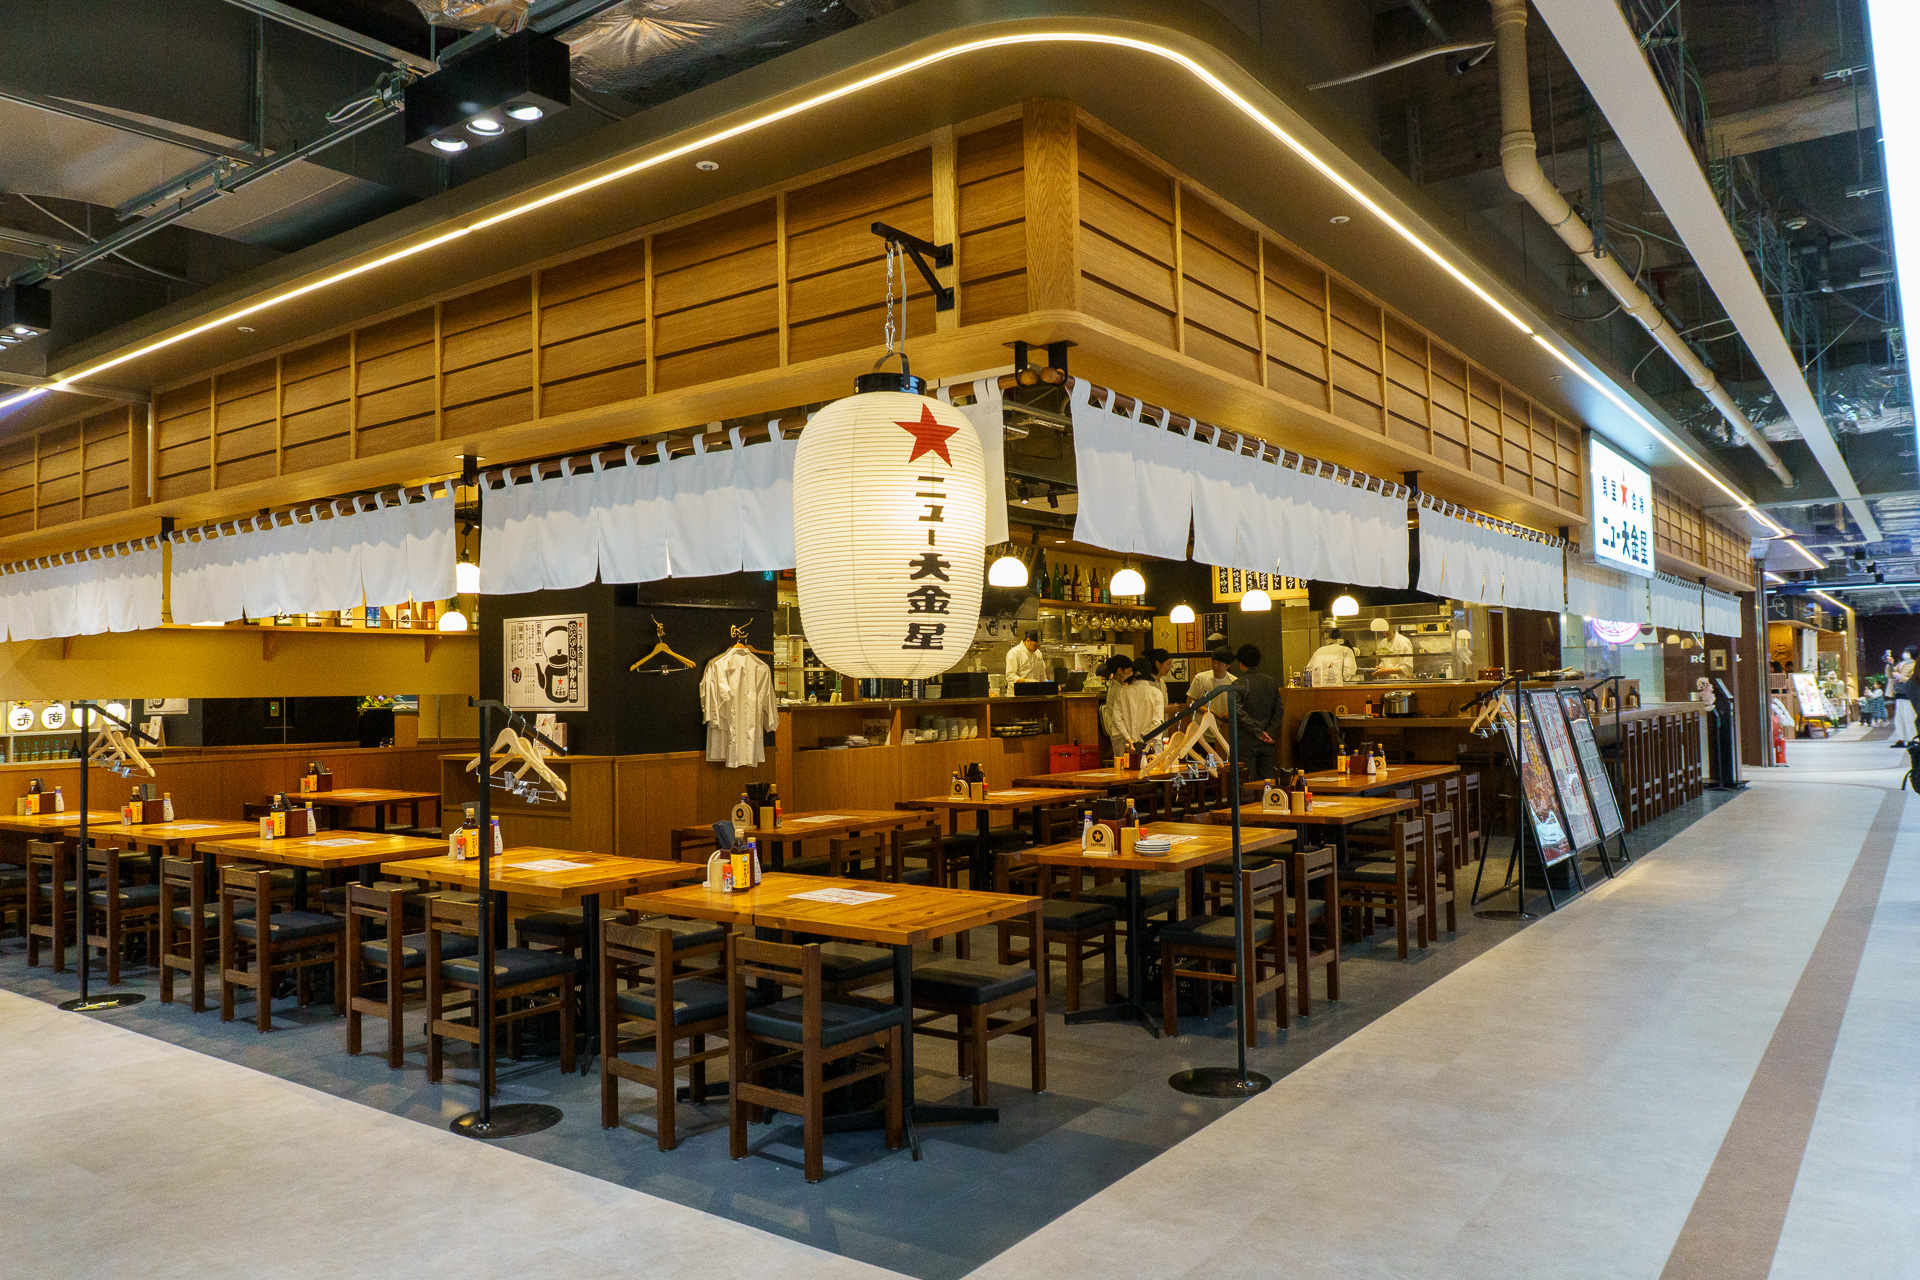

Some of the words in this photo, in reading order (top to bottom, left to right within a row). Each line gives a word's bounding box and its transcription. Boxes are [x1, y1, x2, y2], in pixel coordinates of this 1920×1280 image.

[901, 475, 952, 651] ニュー大金星
[1602, 516, 1649, 565] ニュー大金星
